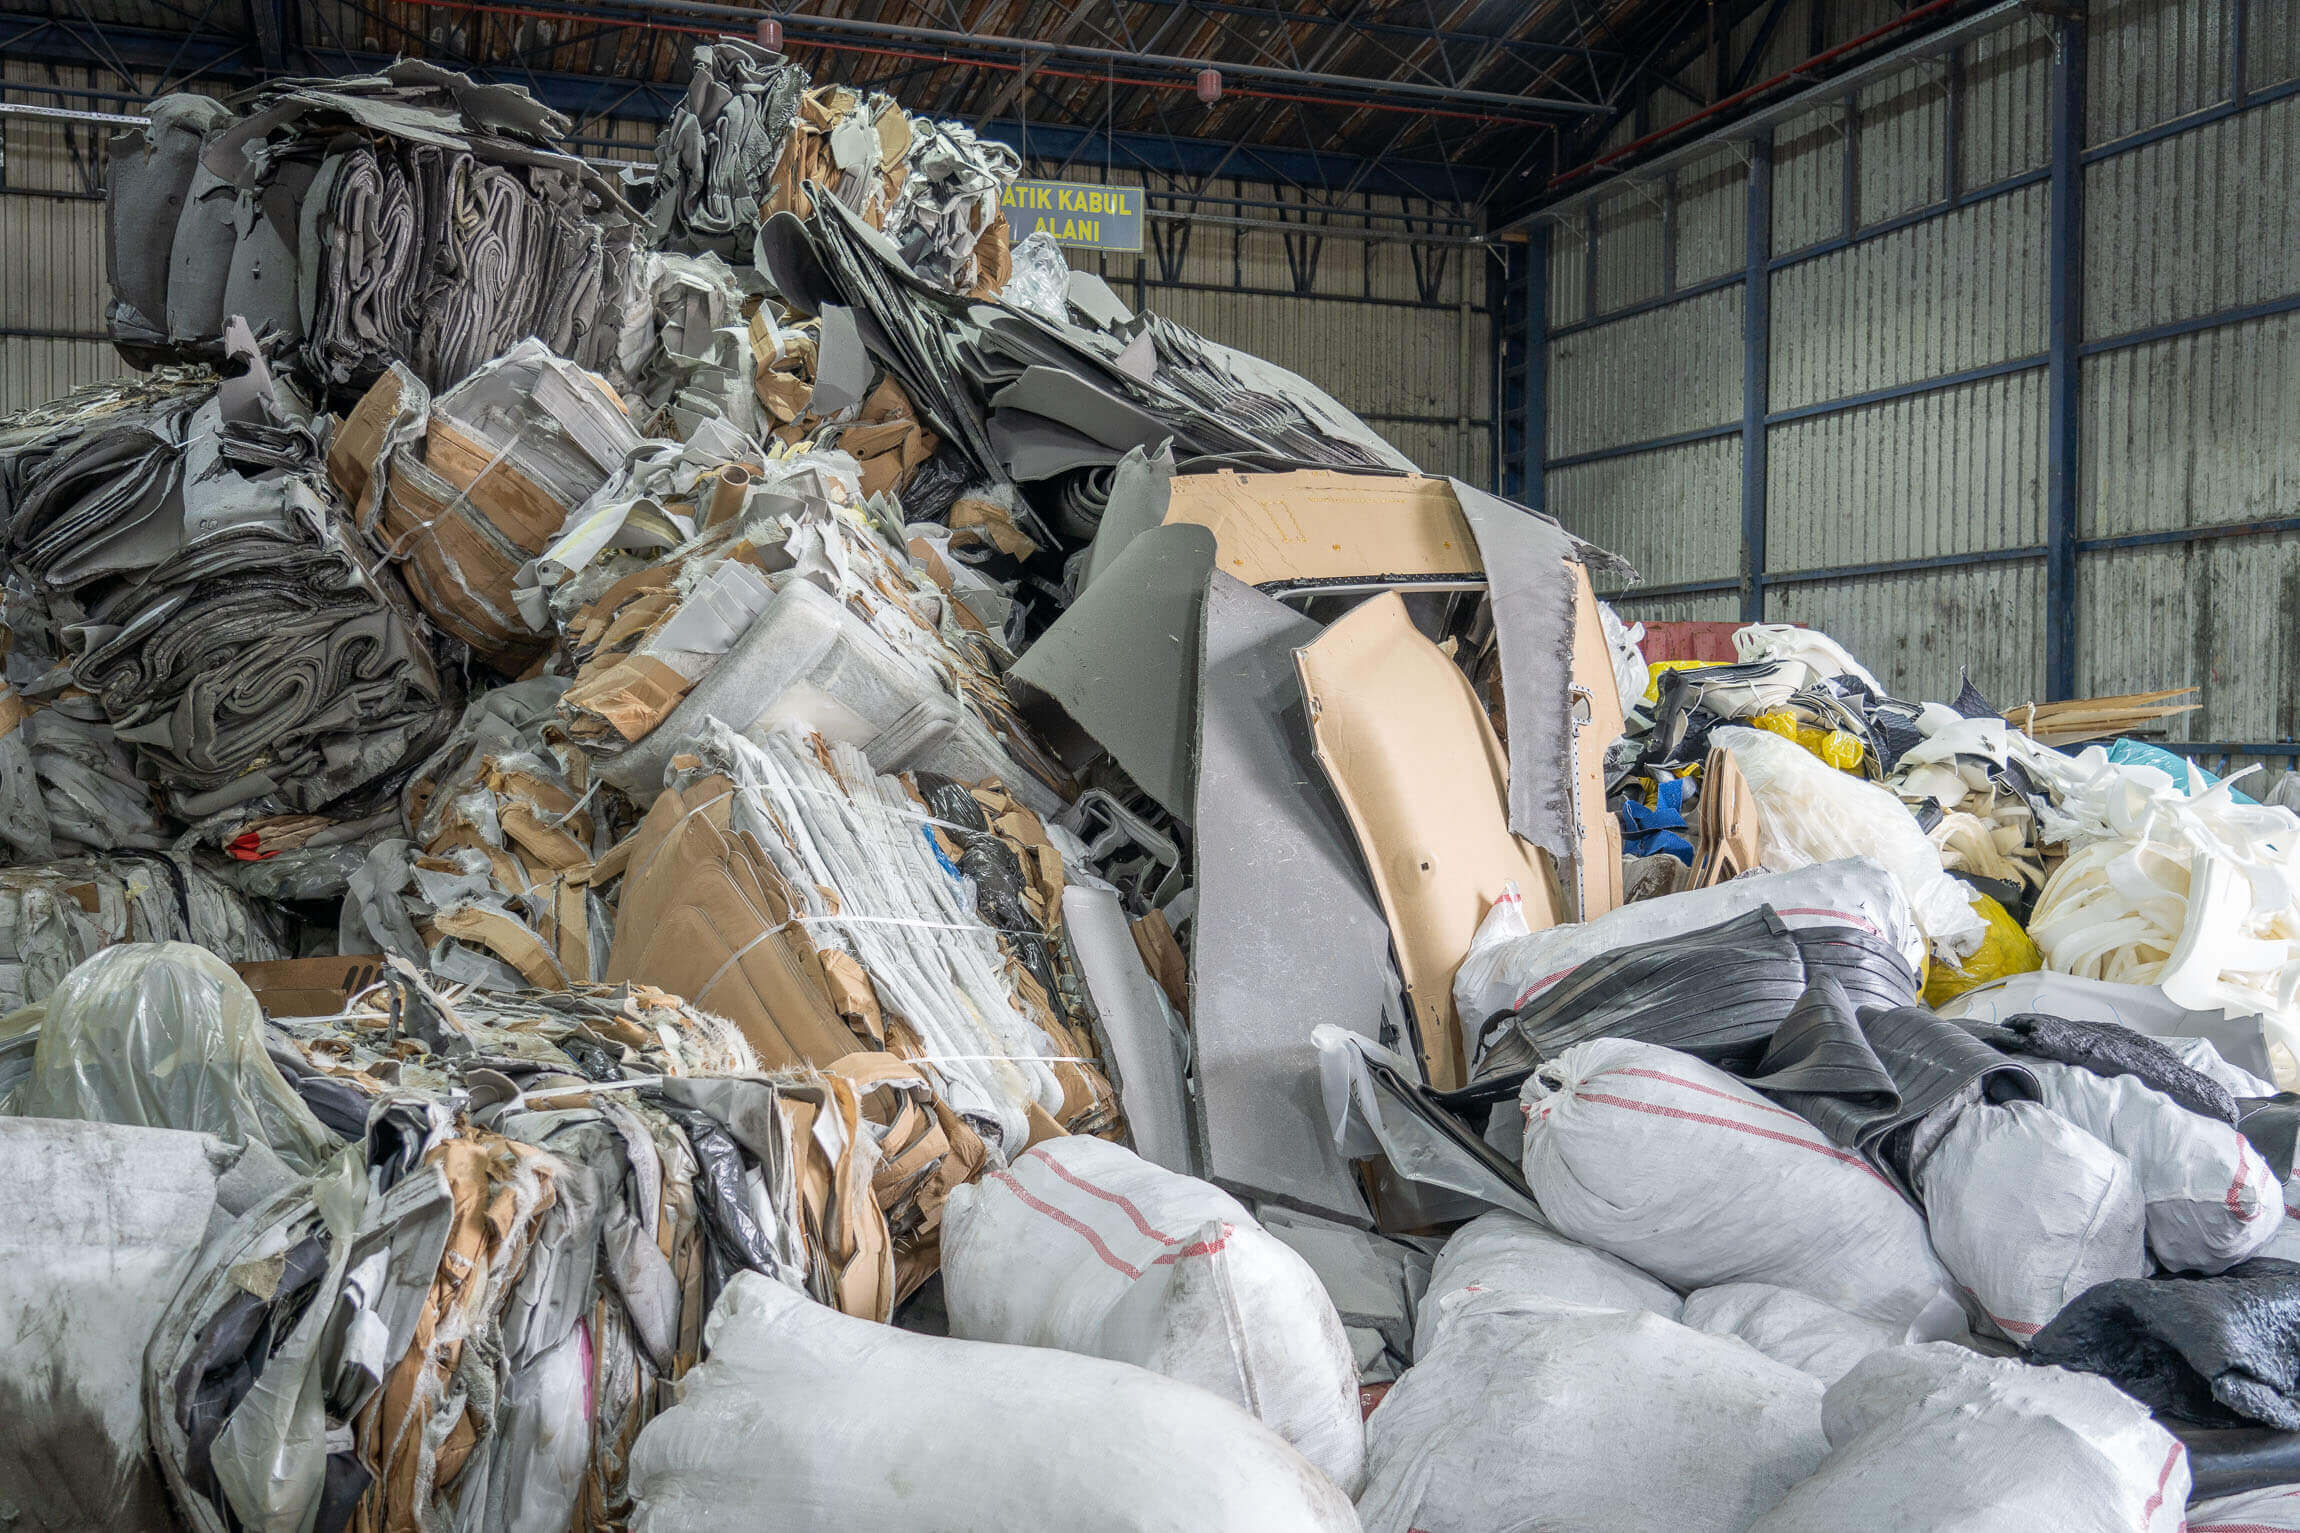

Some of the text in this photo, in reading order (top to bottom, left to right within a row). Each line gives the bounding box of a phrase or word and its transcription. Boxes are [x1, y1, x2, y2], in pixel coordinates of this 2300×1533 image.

[1001, 185, 1132, 216] ATIK KABUL
[1034, 217, 1100, 242] ALANI
